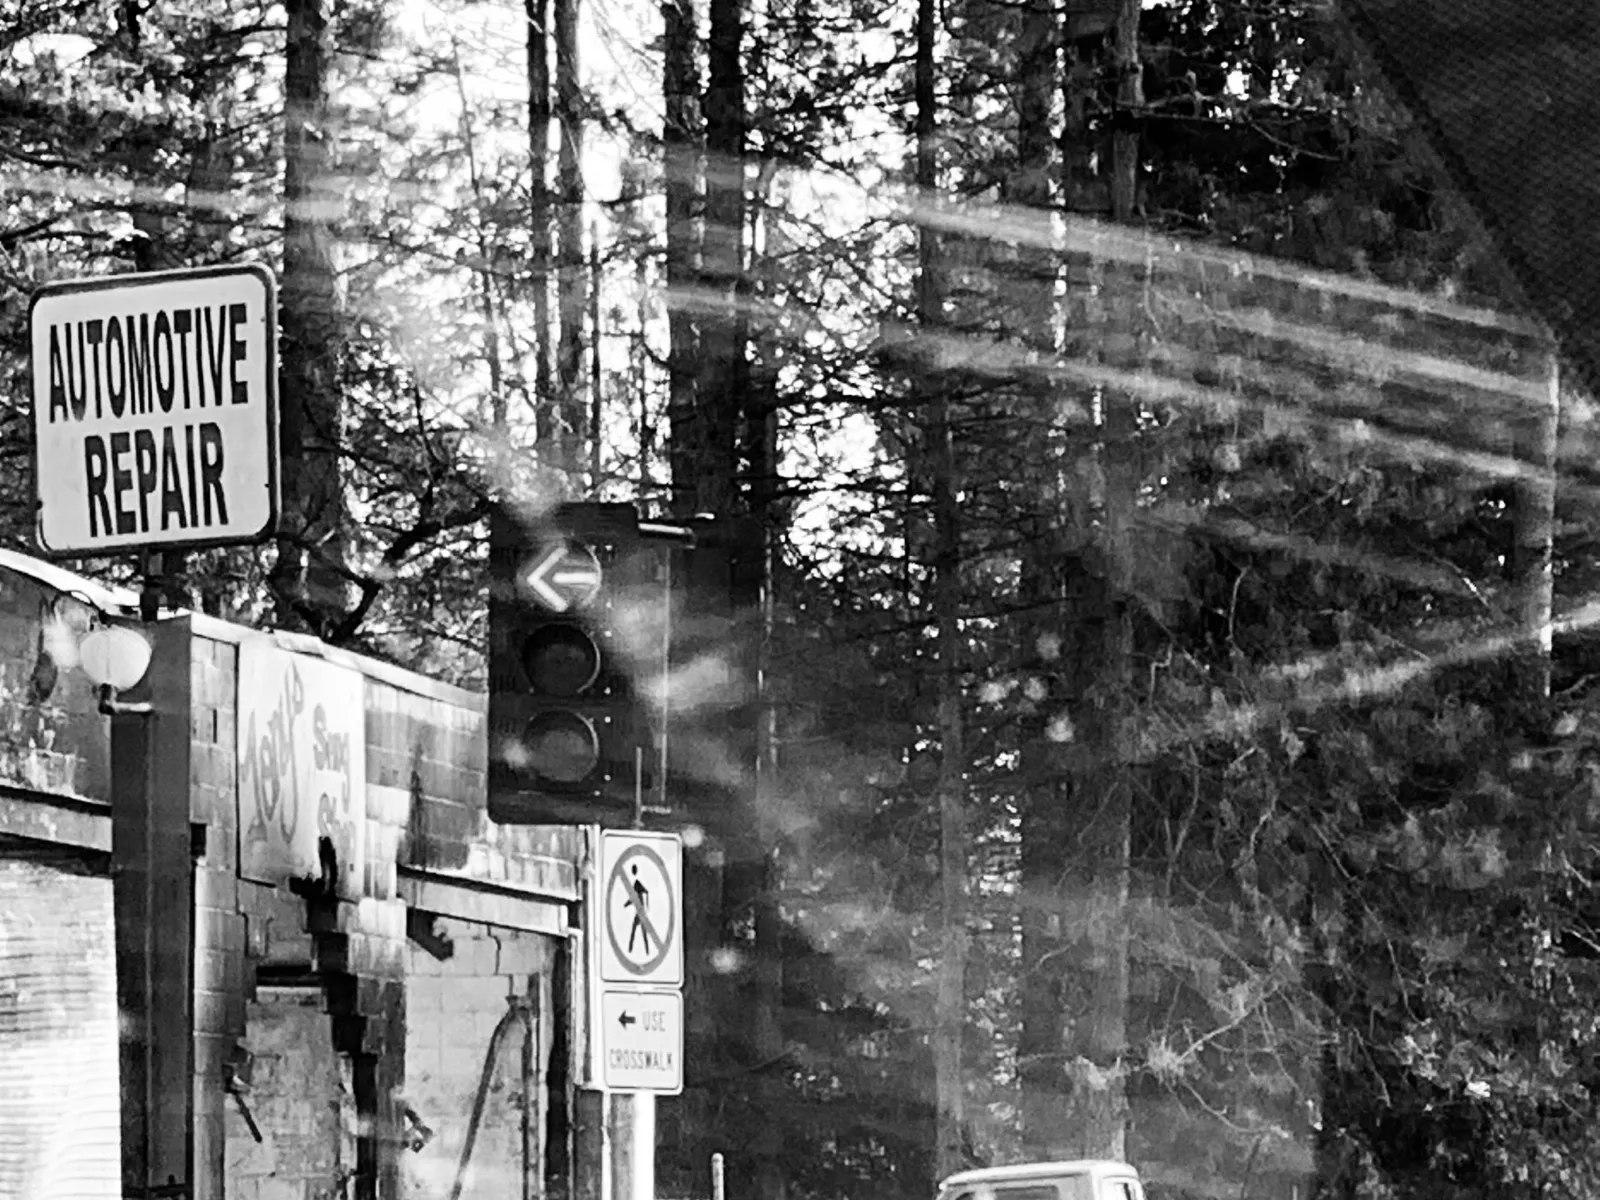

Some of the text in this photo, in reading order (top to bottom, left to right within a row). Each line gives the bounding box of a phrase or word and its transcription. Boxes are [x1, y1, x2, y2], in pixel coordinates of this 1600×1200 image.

[49, 303, 249, 424] AUTOMOTIVE
[84, 422, 229, 538] REPAIR
[642, 1010, 666, 1032] USE
[609, 1048, 674, 1072] CROSSWALK
